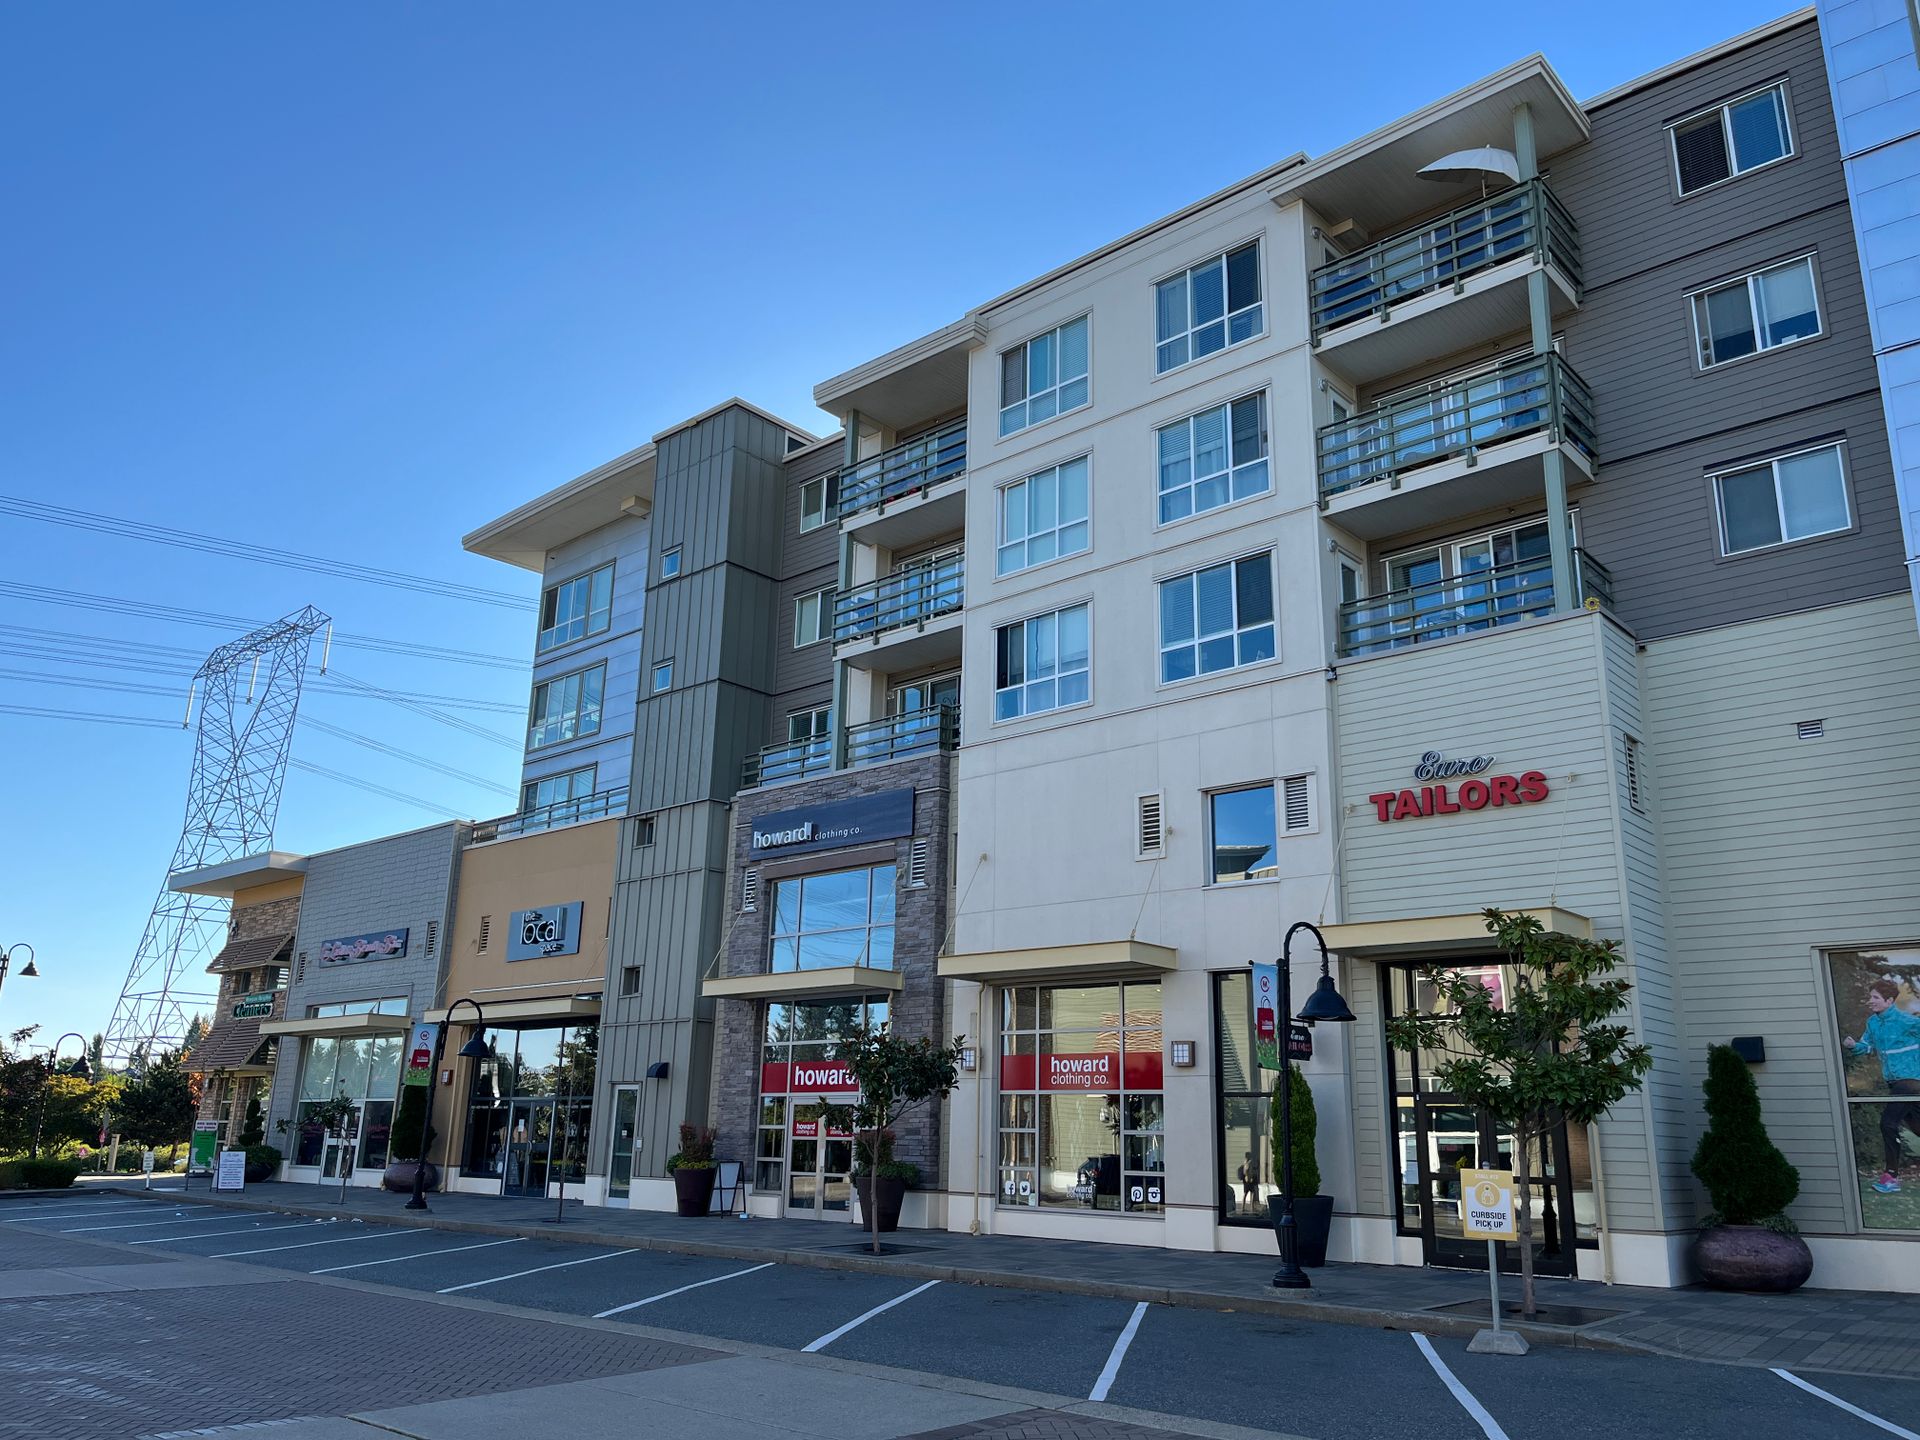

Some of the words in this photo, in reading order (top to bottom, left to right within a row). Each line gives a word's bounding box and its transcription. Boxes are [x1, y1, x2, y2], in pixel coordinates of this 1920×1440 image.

[1414, 750, 1496, 783] Euro
[1369, 770, 1549, 822] TAILORS
[753, 822, 812, 848] howard
[814, 828, 848, 840] clothing
[850, 826, 862, 834] co.
[525, 909, 535, 921] the
[520, 907, 560, 944] local
[540, 943, 556, 955] space
[1051, 1055, 1108, 1072] howard
[1051, 1072, 1090, 1087] clothing
[1093, 1075, 1109, 1085] co.
[1471, 1210, 1507, 1220] CURBSIDE
[1475, 1219, 1492, 1228] PICK
